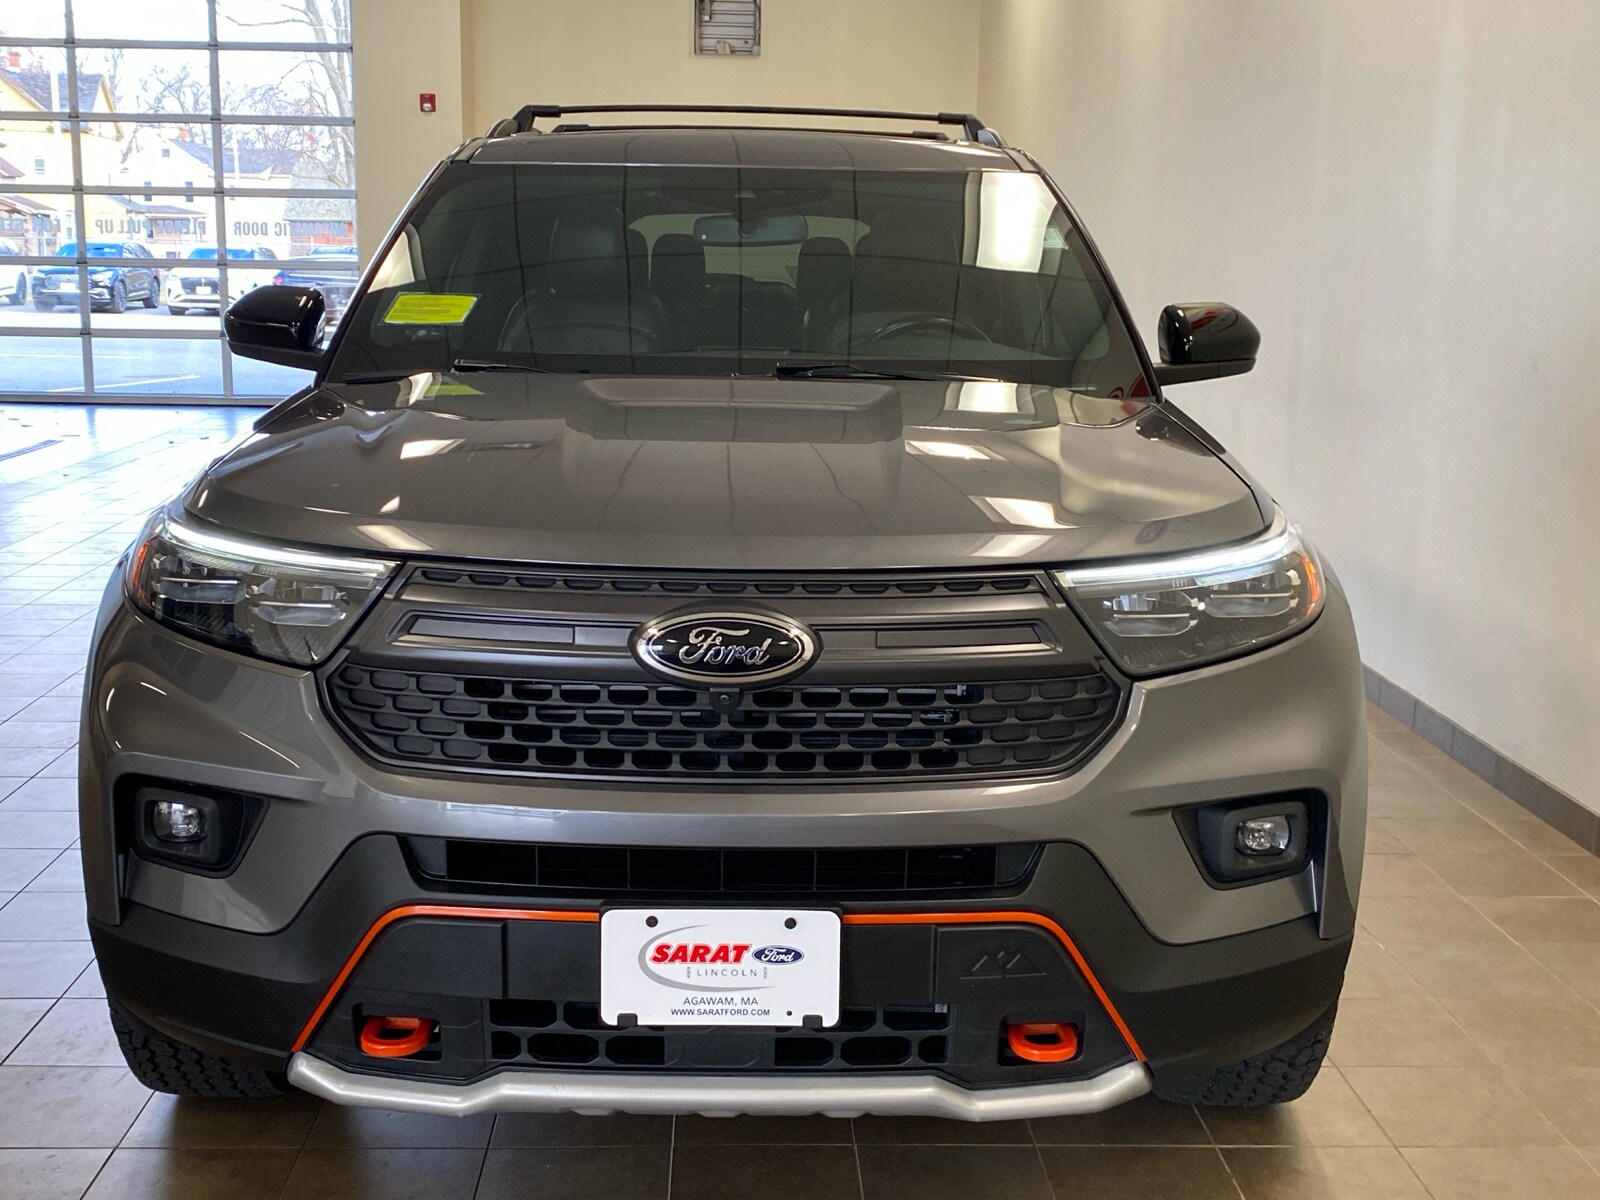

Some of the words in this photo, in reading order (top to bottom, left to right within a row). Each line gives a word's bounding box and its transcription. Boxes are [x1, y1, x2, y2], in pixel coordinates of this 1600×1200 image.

[678, 626, 773, 666] Ford
[650, 943, 752, 964] SARAT
[761, 948, 795, 963] Ford
[696, 968, 758, 977] LINCOLN
[683, 996, 738, 1007] AGAWAM,
[740, 996, 759, 1006] MA
[671, 1008, 771, 1016] WWW.SARATFORD.COM
